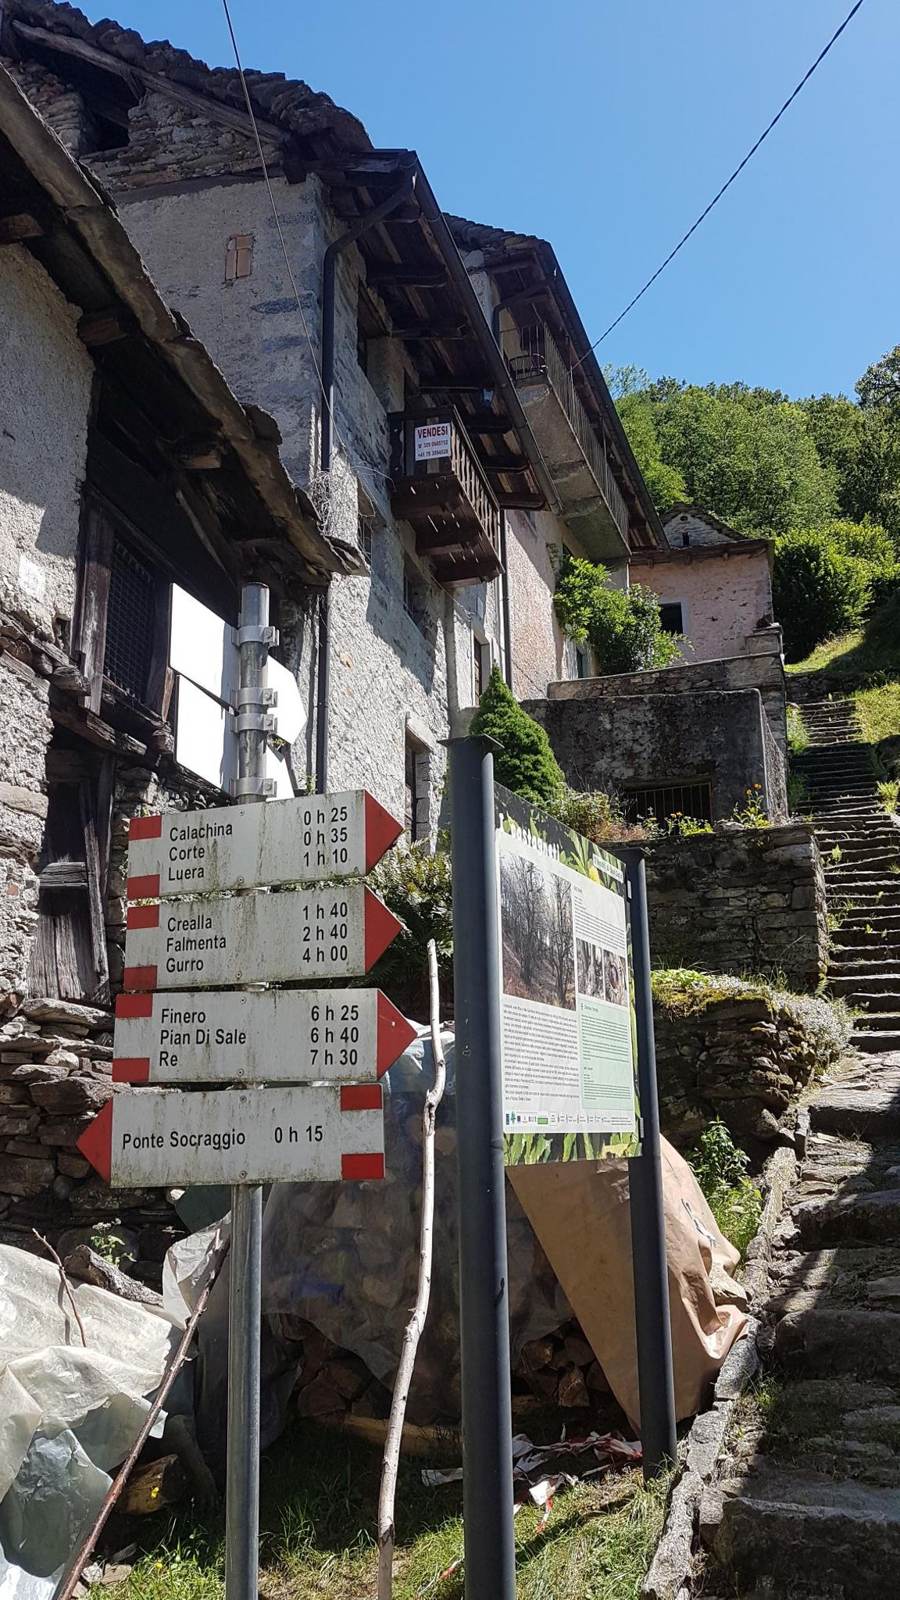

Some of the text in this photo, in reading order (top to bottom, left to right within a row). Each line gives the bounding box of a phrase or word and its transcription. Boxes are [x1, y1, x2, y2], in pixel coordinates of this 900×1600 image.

[417, 426, 448, 439] VENDESI
[169, 806, 348, 842] Calachina 0 h 25
[168, 826, 348, 862] Corte 0 h 35
[168, 847, 348, 882] Luera 1 h 10
[167, 901, 348, 933] Crealla 1 h 40
[166, 923, 348, 953] Falmenta 2 h 40
[165, 944, 348, 973] Gurro 4 h 00
[161, 1004, 359, 1024] Finero 6 h 25
[160, 1026, 359, 1046] Pian Di Sale 6 h 40
[159, 1048, 358, 1067] Re 7 h 30
[122, 1125, 323, 1151] Ponte Socraggio 0 h 15
